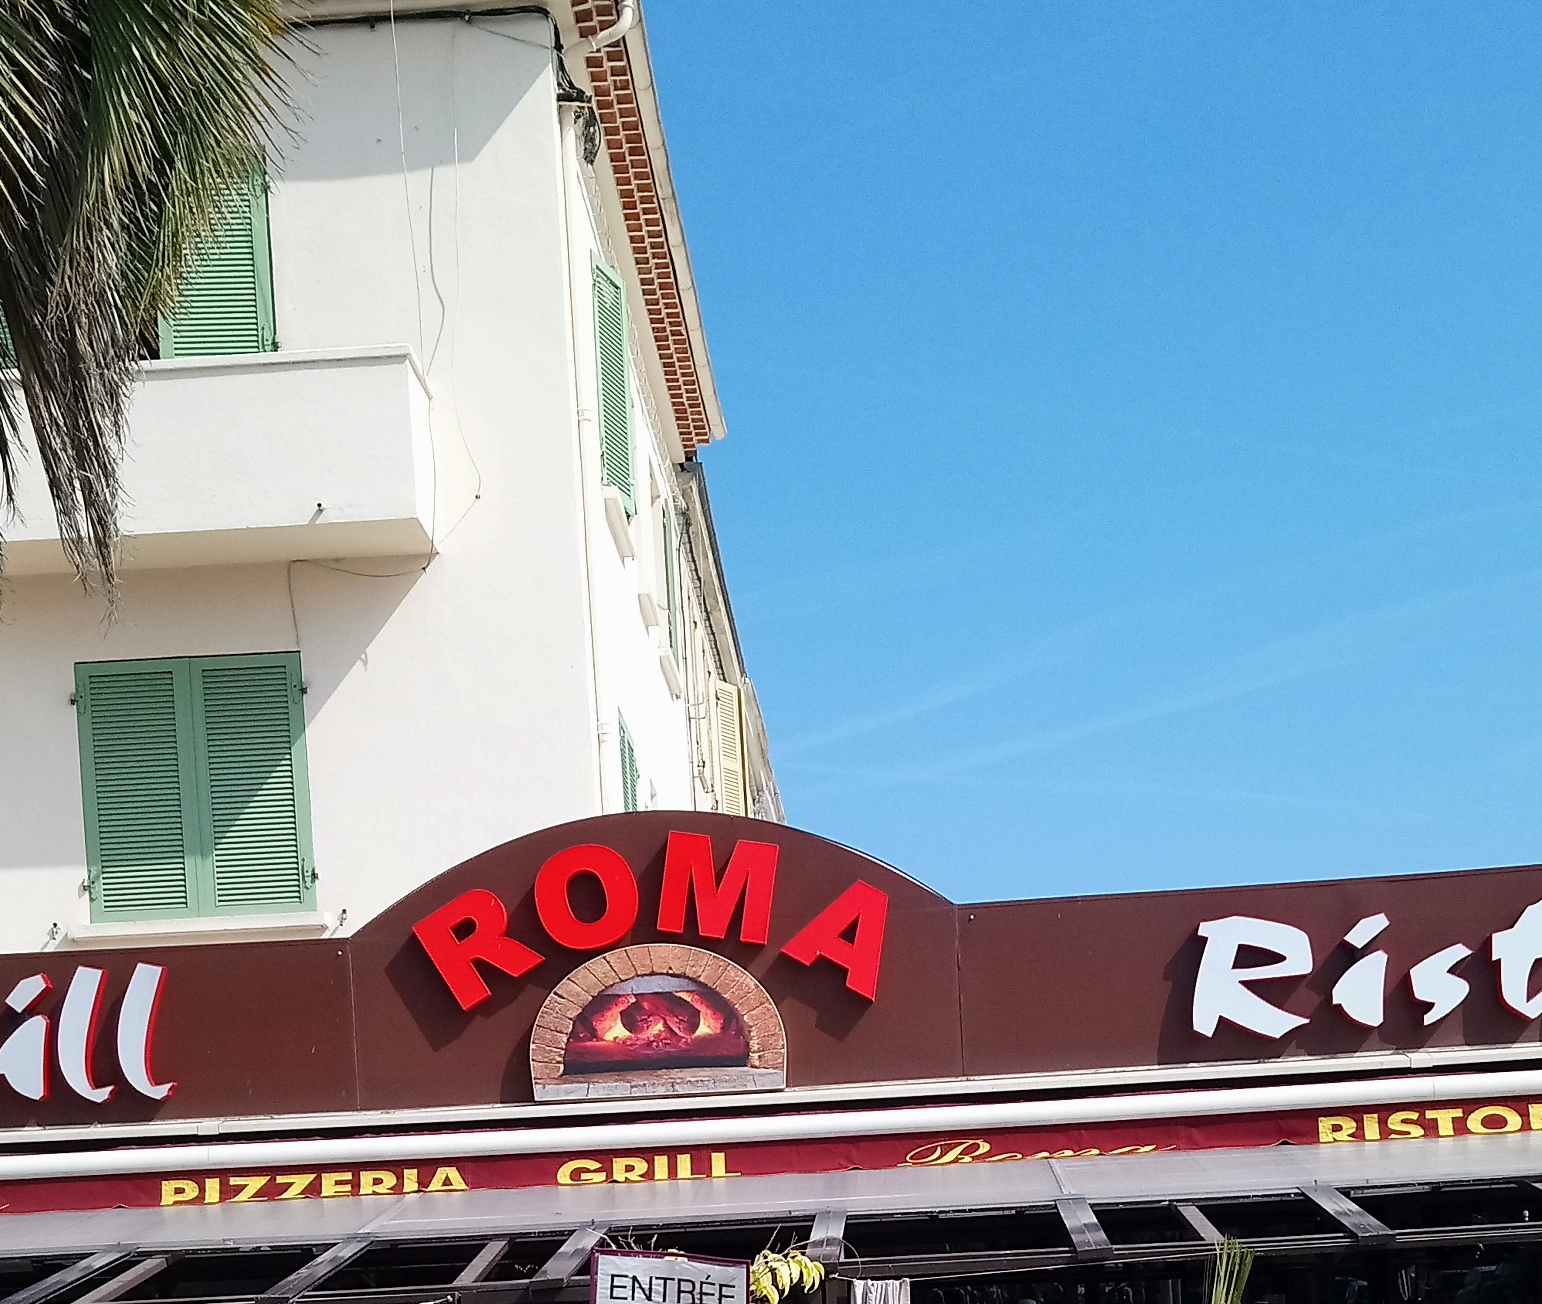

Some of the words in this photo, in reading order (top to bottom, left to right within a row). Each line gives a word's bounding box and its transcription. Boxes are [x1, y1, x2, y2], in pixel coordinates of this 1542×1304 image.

[412, 830, 889, 1011] ROMA
[159, 1165, 469, 1207] PIZZERIA
[556, 1151, 741, 1186] GRILL
